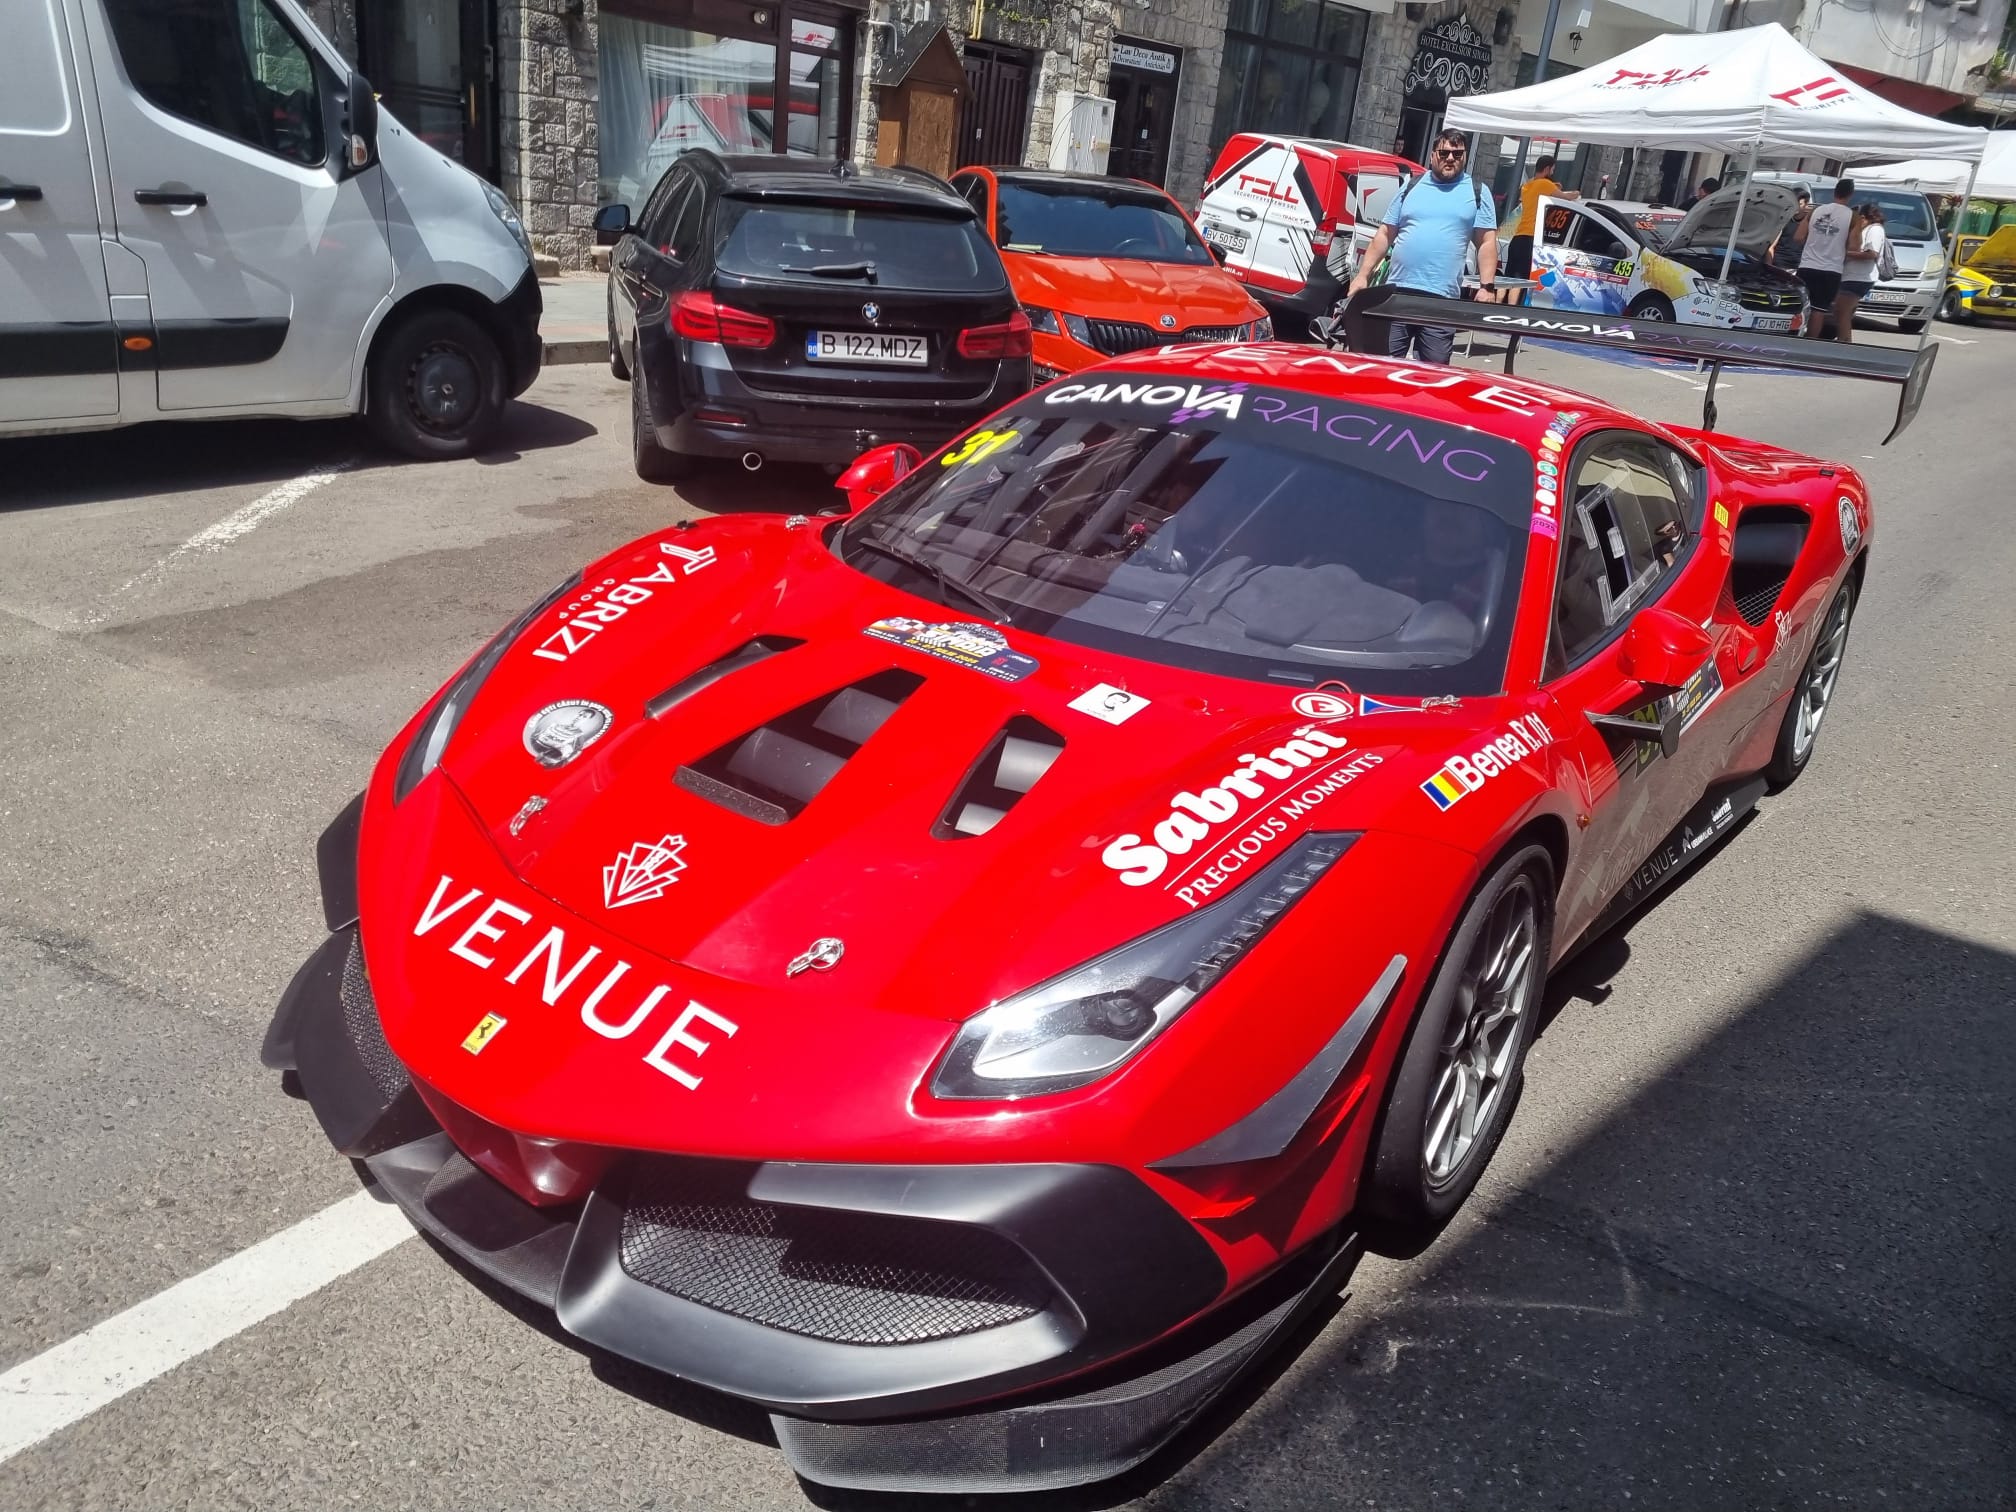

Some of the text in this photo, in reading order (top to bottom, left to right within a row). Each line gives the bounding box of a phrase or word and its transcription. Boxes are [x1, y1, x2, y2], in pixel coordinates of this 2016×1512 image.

[1421, 35, 1490, 62] HOTEL EXCELSIOR SINAIA
[1546, 209, 1570, 230] 435
[1613, 260, 1633, 276] 435
[807, 345, 817, 353] RO
[821, 334, 836, 354] B
[1482, 315, 1790, 357] CANOVA RACING
[1158, 342, 1553, 417] VENUE
[941, 430, 1019, 467] 31
[1044, 383, 1497, 482] CANOVA RACING
[1533, 519, 1556, 533] 2025
[532, 542, 718, 662] TABRIZI
[559, 578, 616, 619] GROUP
[1444, 732, 1530, 792] Benea
[1102, 727, 1348, 887] Sabrini
[1175, 752, 1385, 909] PRECIOUS MOMENTS
[1633, 845, 1679, 891] VENUE
[413, 874, 740, 1091] VENUE
